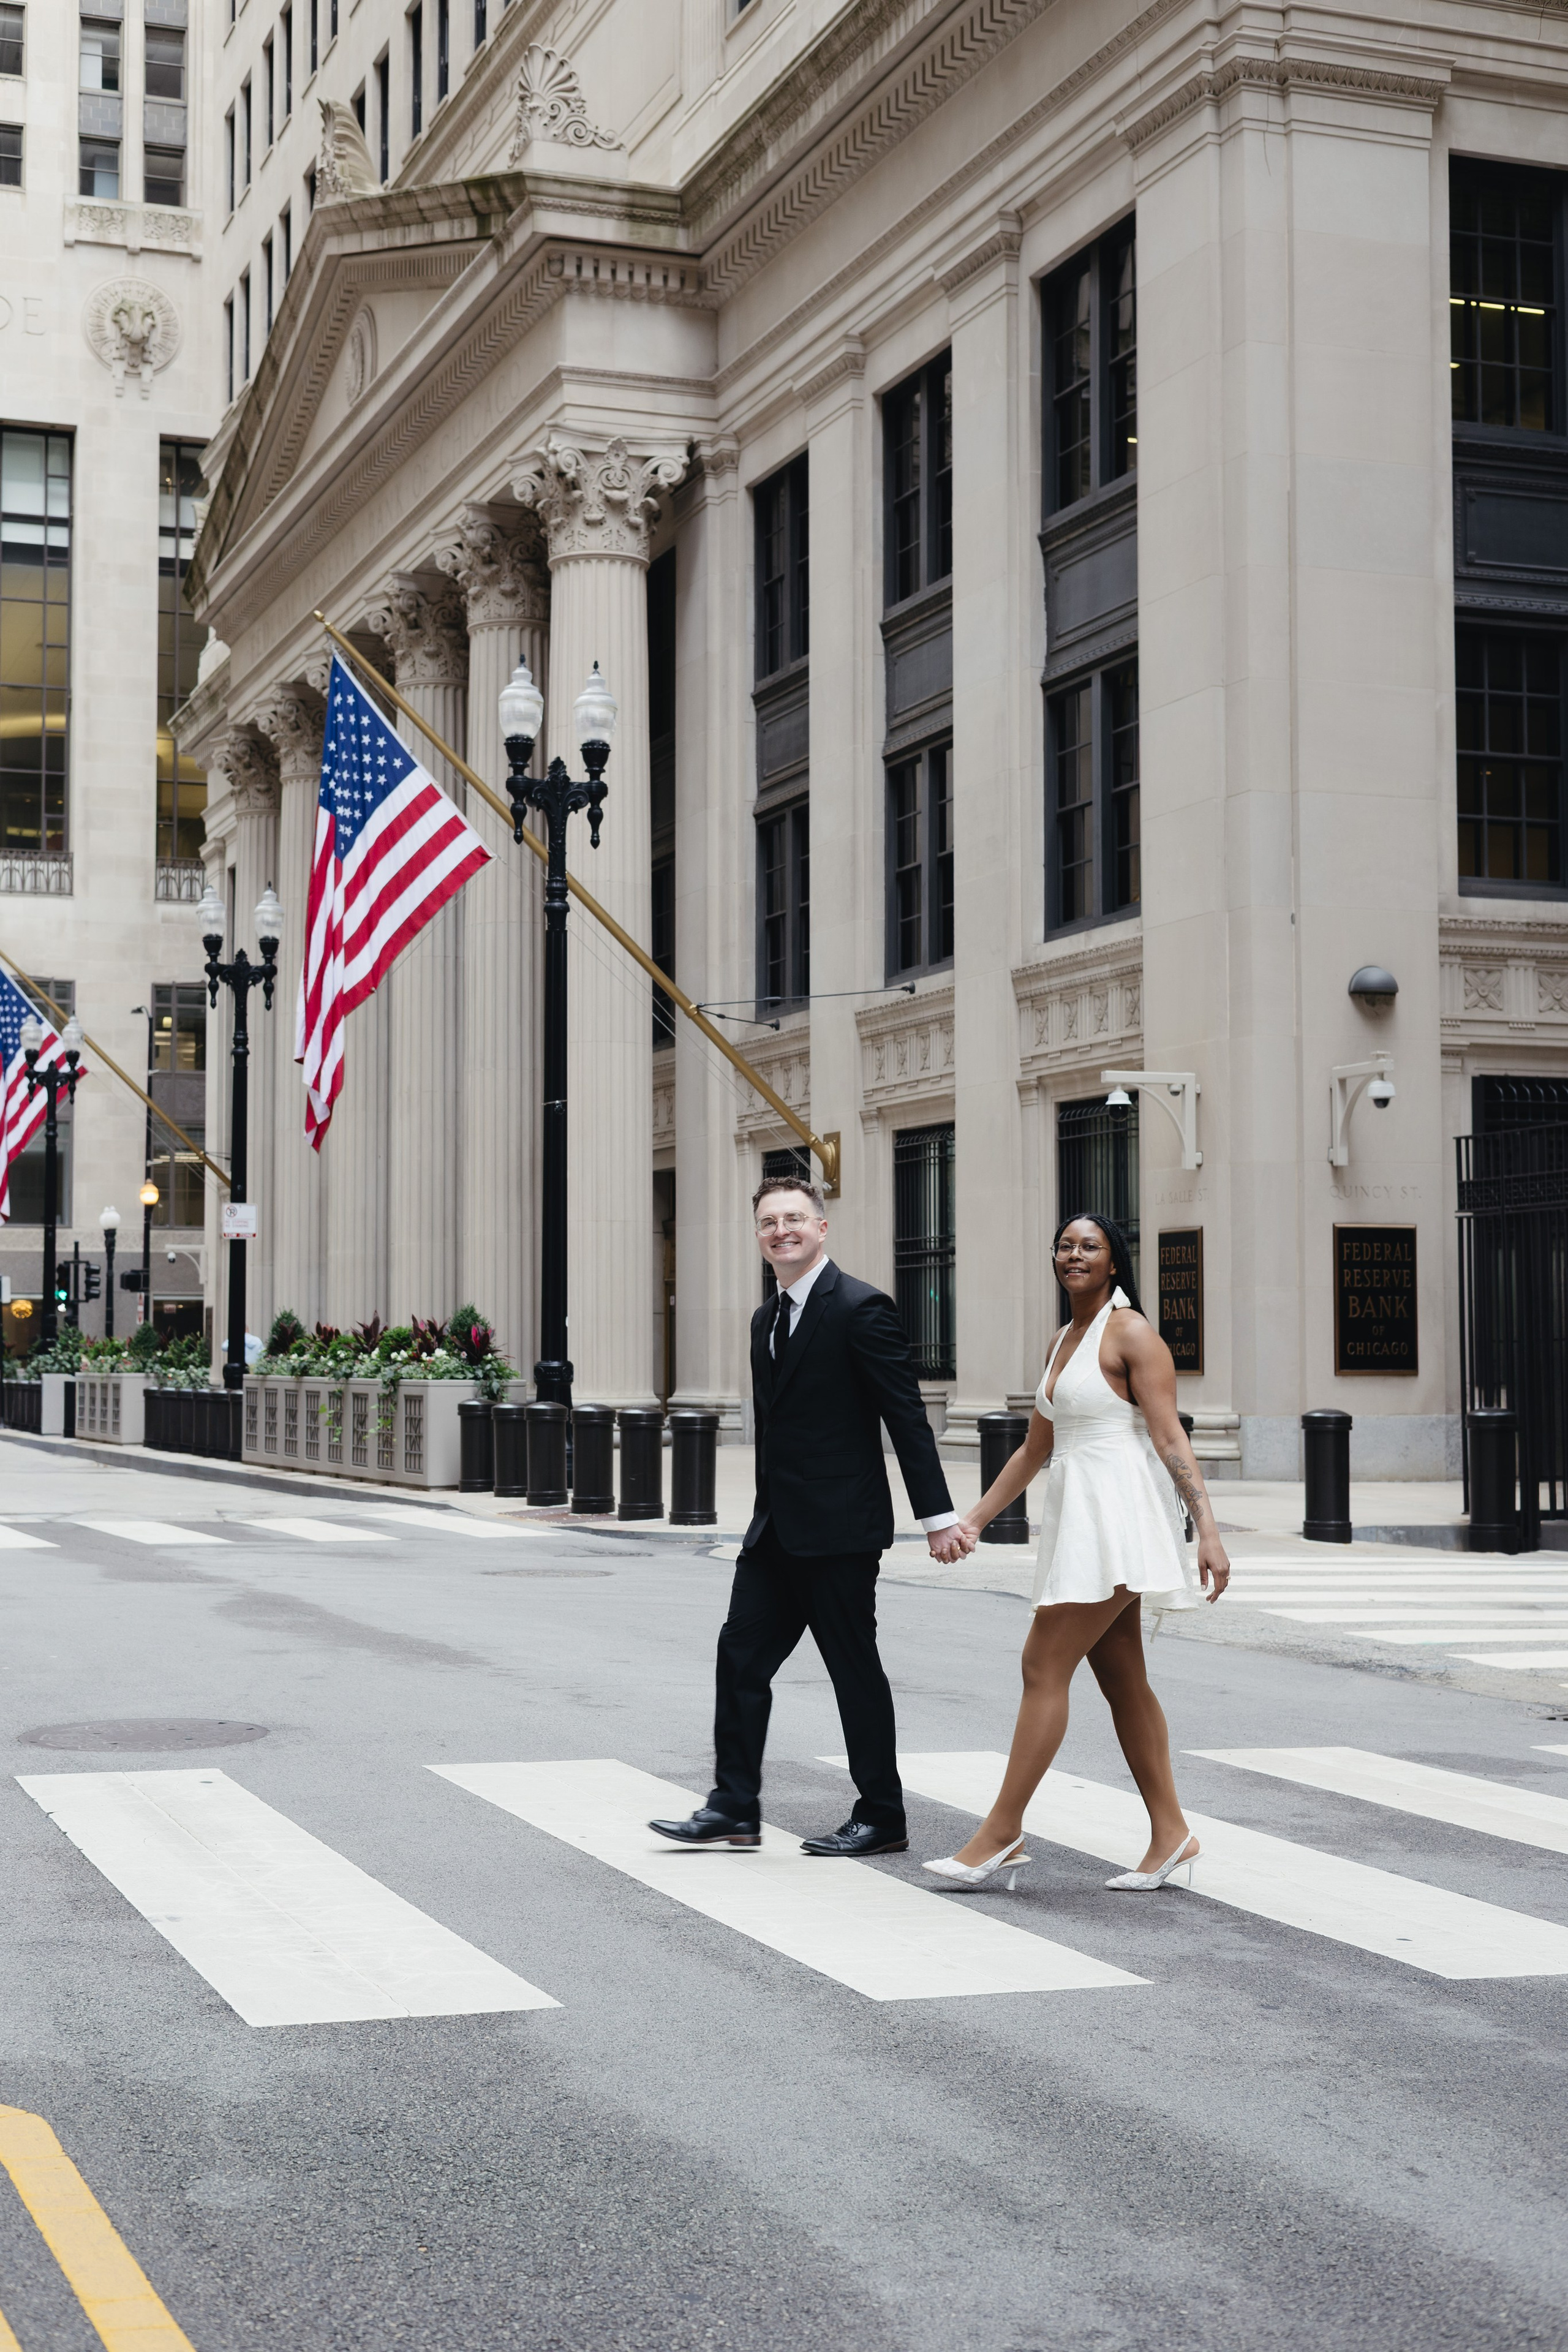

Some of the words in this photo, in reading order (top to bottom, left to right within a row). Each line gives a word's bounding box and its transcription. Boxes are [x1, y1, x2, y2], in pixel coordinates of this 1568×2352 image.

[368, 477, 404, 548] BANK
[412, 451, 430, 503] OF
[439, 356, 522, 476] CHICAGO
[1155, 1193, 1166, 1205] LA
[1169, 1189, 1193, 1204] SALLE
[1329, 1185, 1392, 1200] QUINCY
[1400, 1186, 1422, 1199] ST.
[1161, 1245, 1197, 1265] FEDERAL
[1343, 1242, 1411, 1261] FEDERAL
[1161, 1271, 1196, 1291] RESERVE
[1344, 1268, 1411, 1287] RESERVE
[1164, 1297, 1196, 1320] BANK
[1348, 1295, 1408, 1318] BANK
[1176, 1327, 1183, 1336] OF
[1373, 1325, 1385, 1335] OF
[1348, 1342, 1408, 1355] CHICAGO
